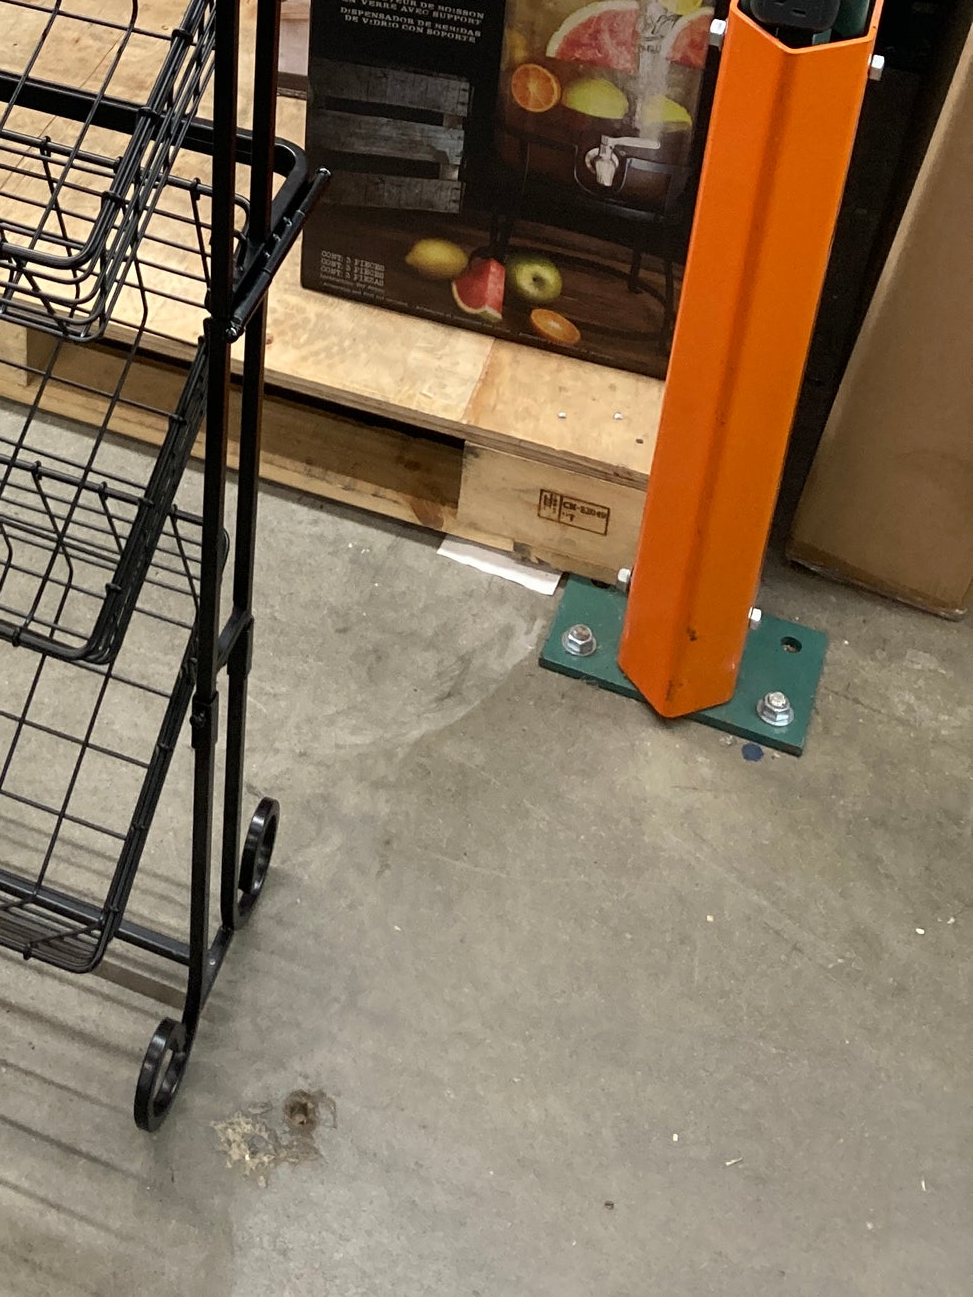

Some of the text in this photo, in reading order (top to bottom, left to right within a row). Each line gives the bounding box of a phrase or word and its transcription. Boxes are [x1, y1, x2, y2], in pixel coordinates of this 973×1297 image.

[419, 0, 435, 10] DE
[400, 4, 428, 15] AVEC
[432, 10, 483, 26] SUPPORT
[344, 14, 359, 23] DE
[401, 23, 424, 34] CON
[426, 28, 476, 43] SOPORTE
[417, 19, 432, 28] DE
